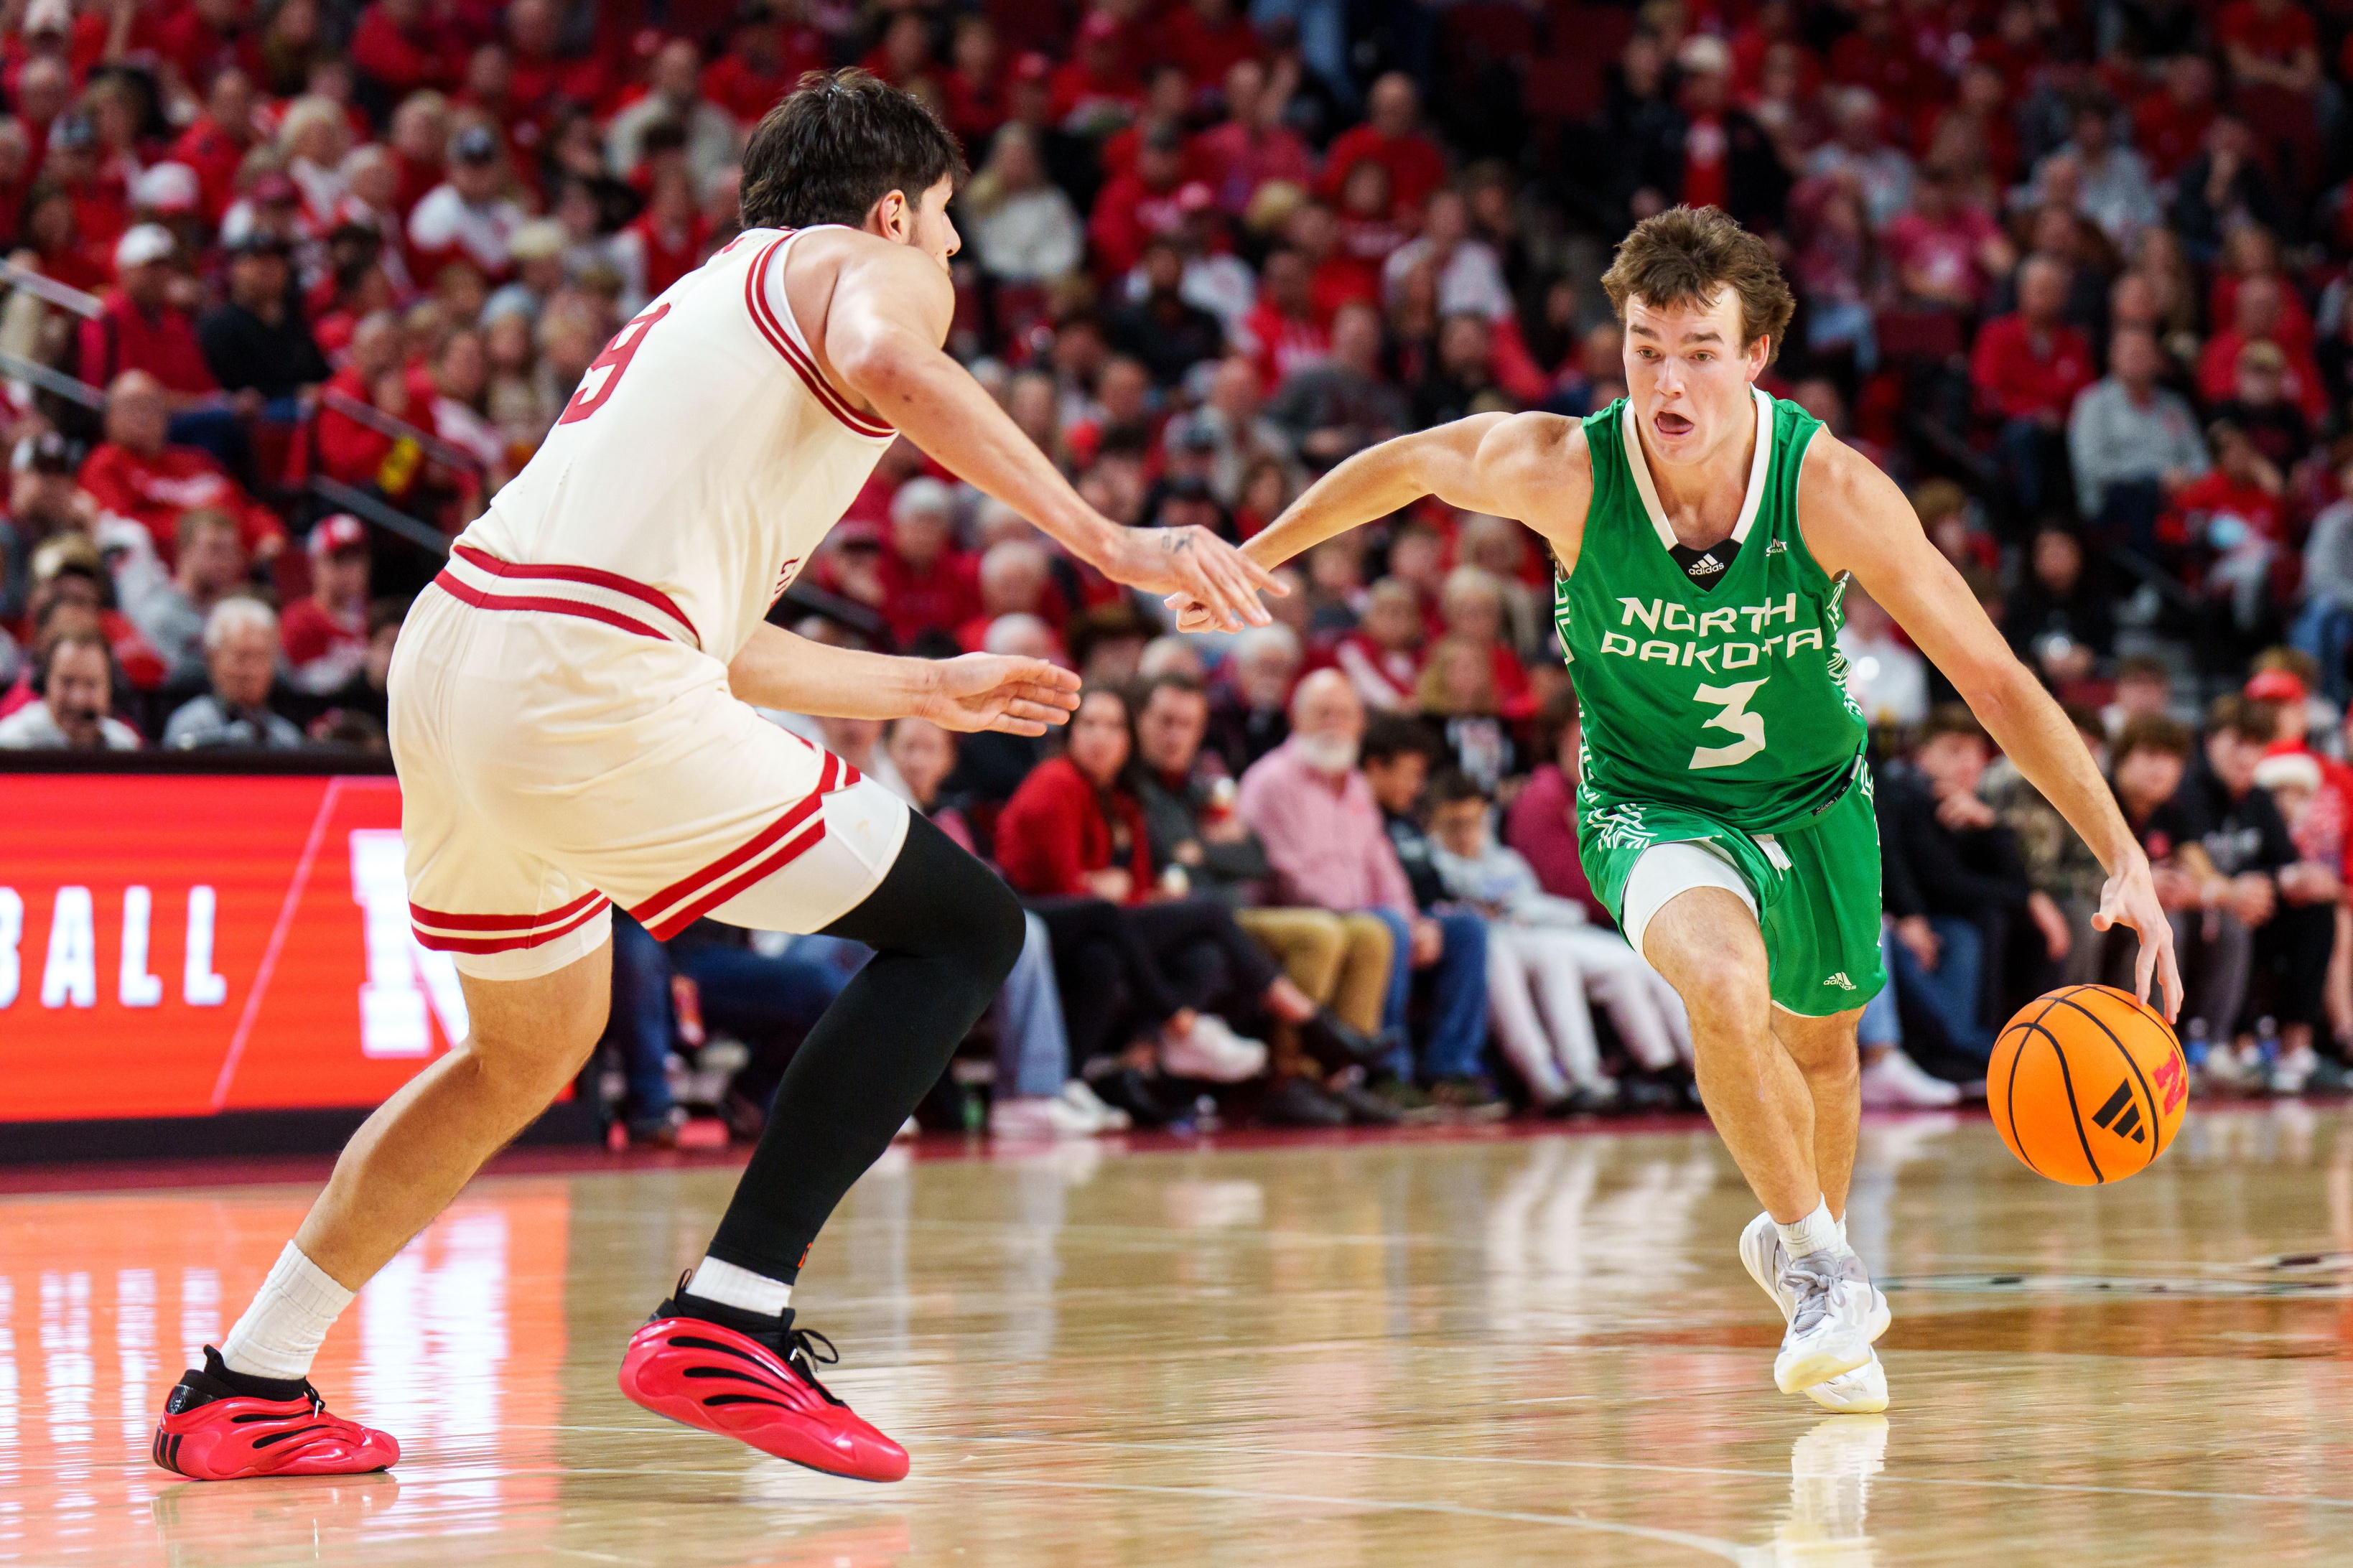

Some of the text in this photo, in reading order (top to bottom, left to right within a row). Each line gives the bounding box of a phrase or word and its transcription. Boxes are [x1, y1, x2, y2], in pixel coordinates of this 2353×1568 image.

[558, 302, 672, 426] 9
[1688, 561, 1725, 576] adidas
[1616, 592, 1797, 638] NORTH
[1600, 626, 1823, 674] DAKOTA
[1687, 675, 1771, 770] 3
[1816, 799, 1835, 815] adidas
[1823, 978, 1857, 991] adidas
